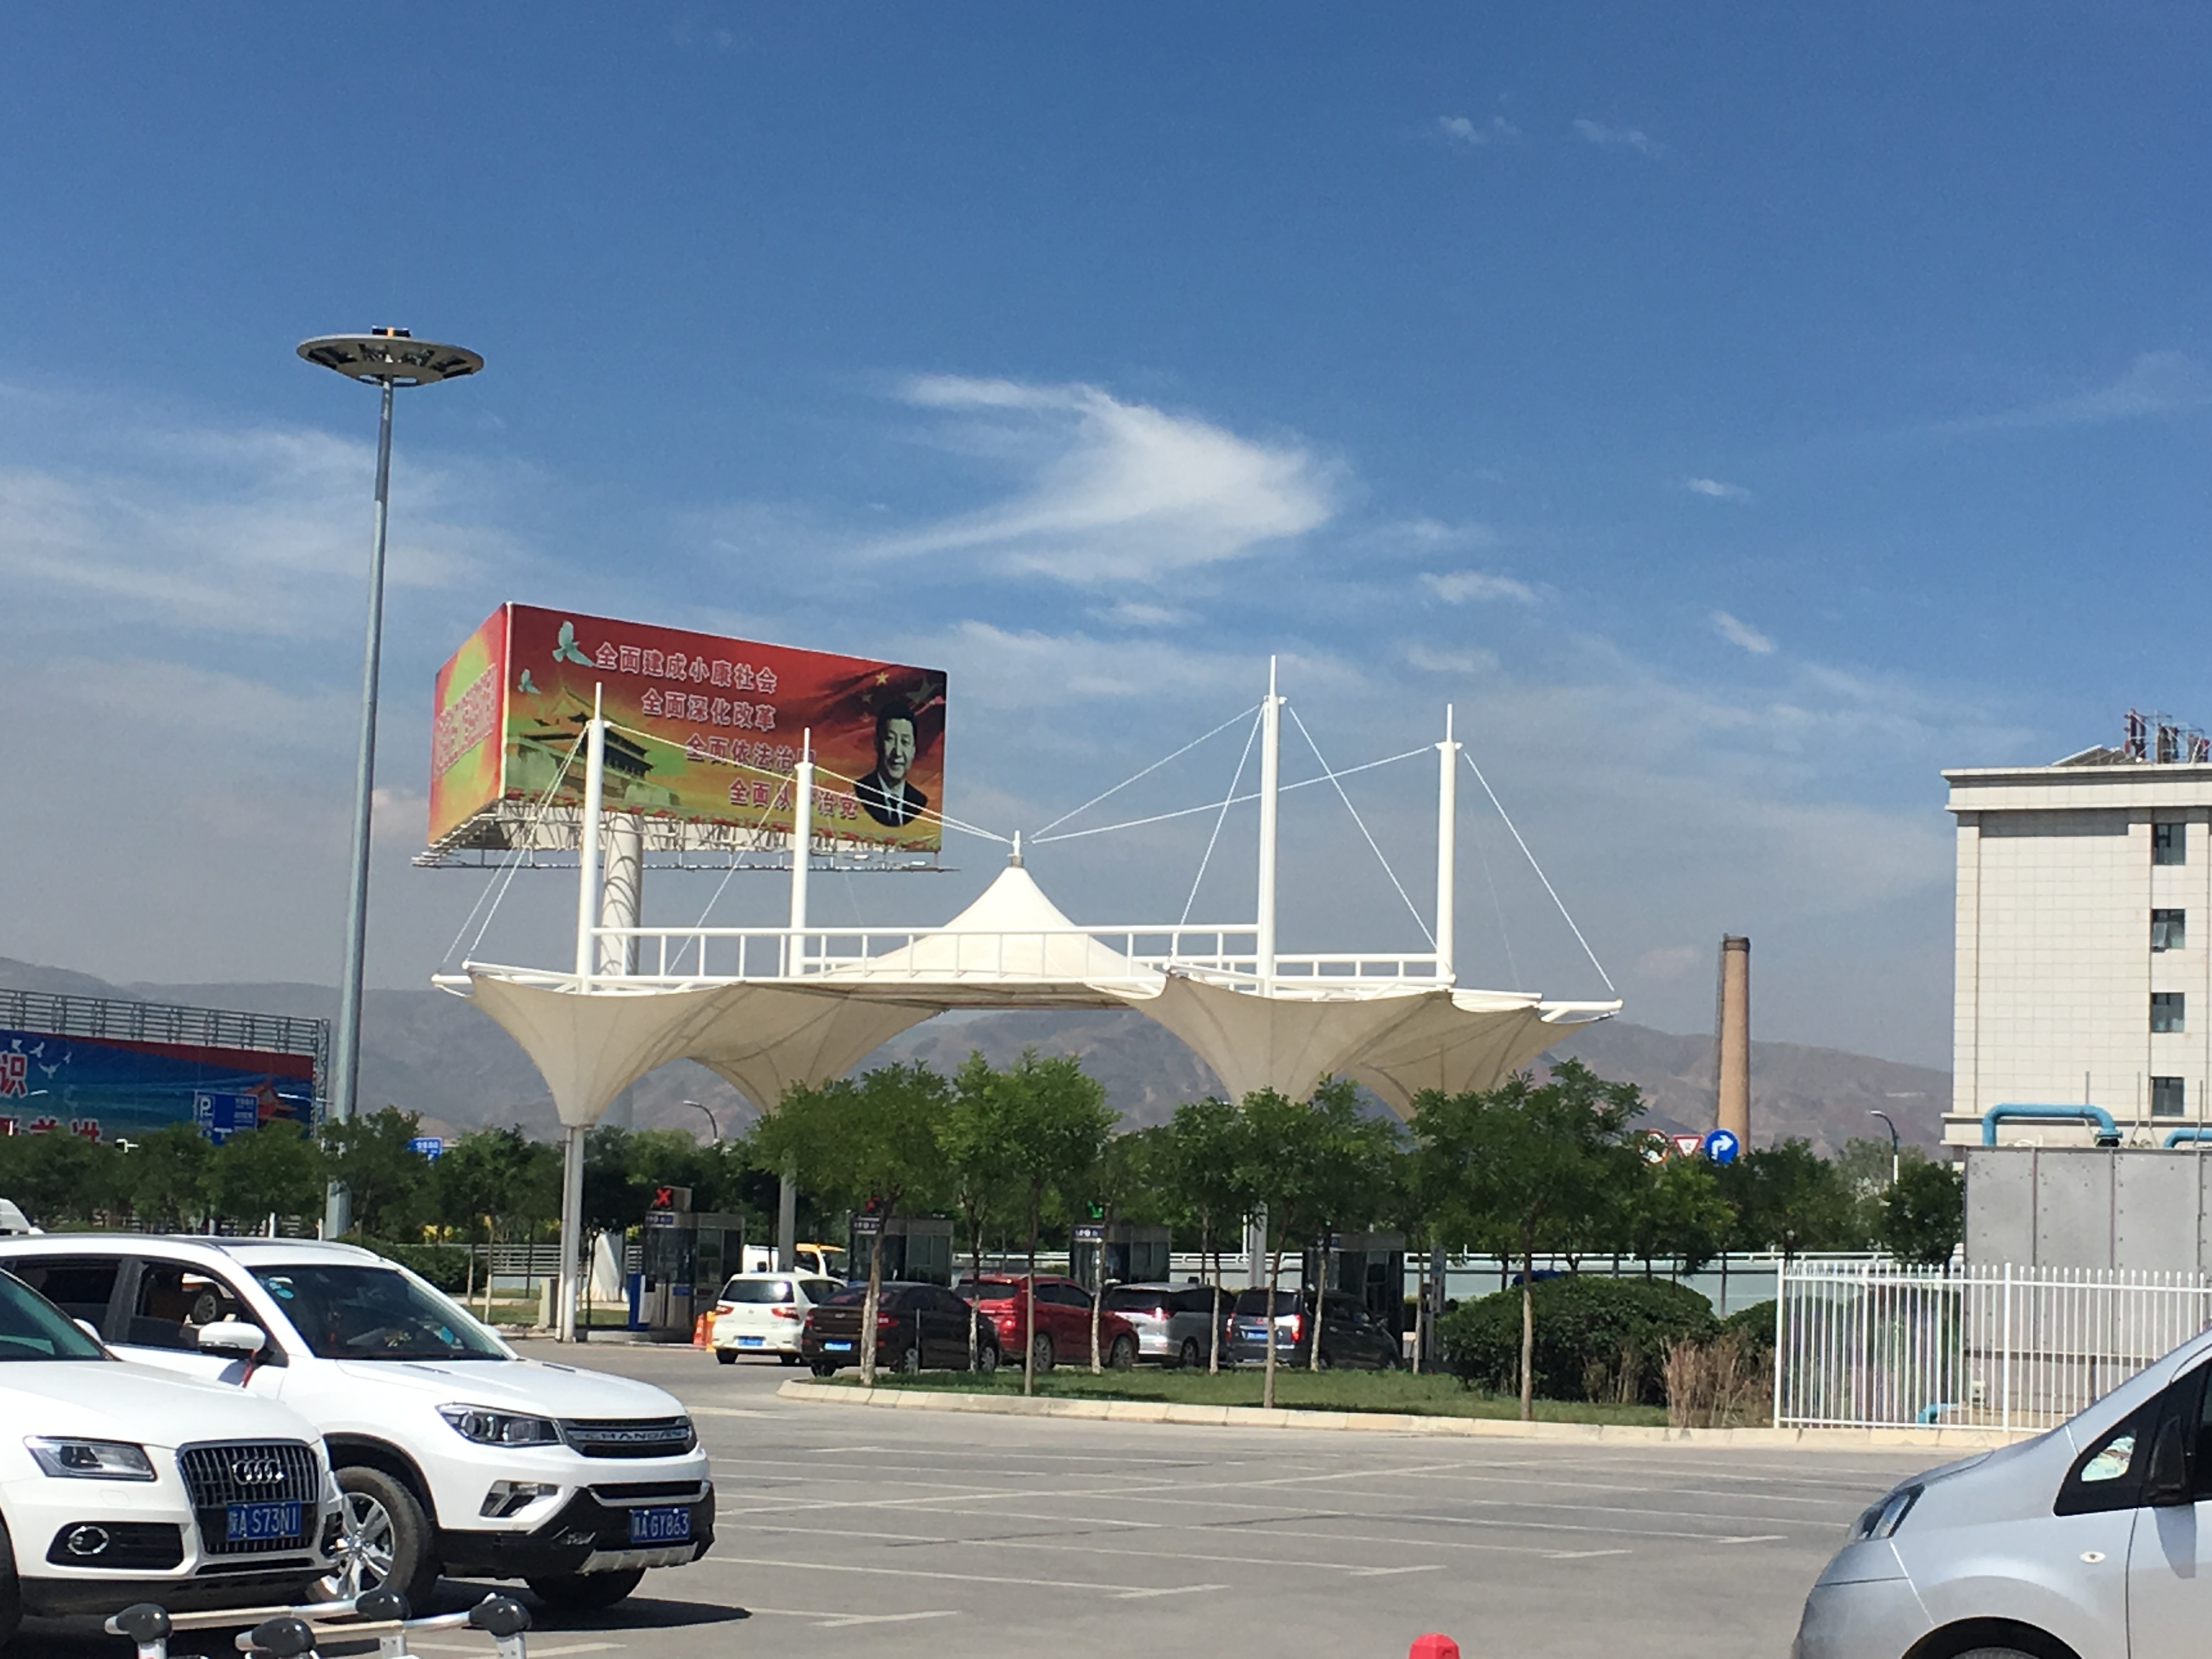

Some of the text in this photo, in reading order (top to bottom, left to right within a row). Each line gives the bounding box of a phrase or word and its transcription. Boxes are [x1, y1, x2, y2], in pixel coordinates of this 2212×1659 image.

[595, 641, 777, 694] 全面建成小康社会
[641, 687, 776, 731] 全面深化改革
[728, 777, 857, 819] 全面从治党
[633, 1513, 689, 1537] AGY863
